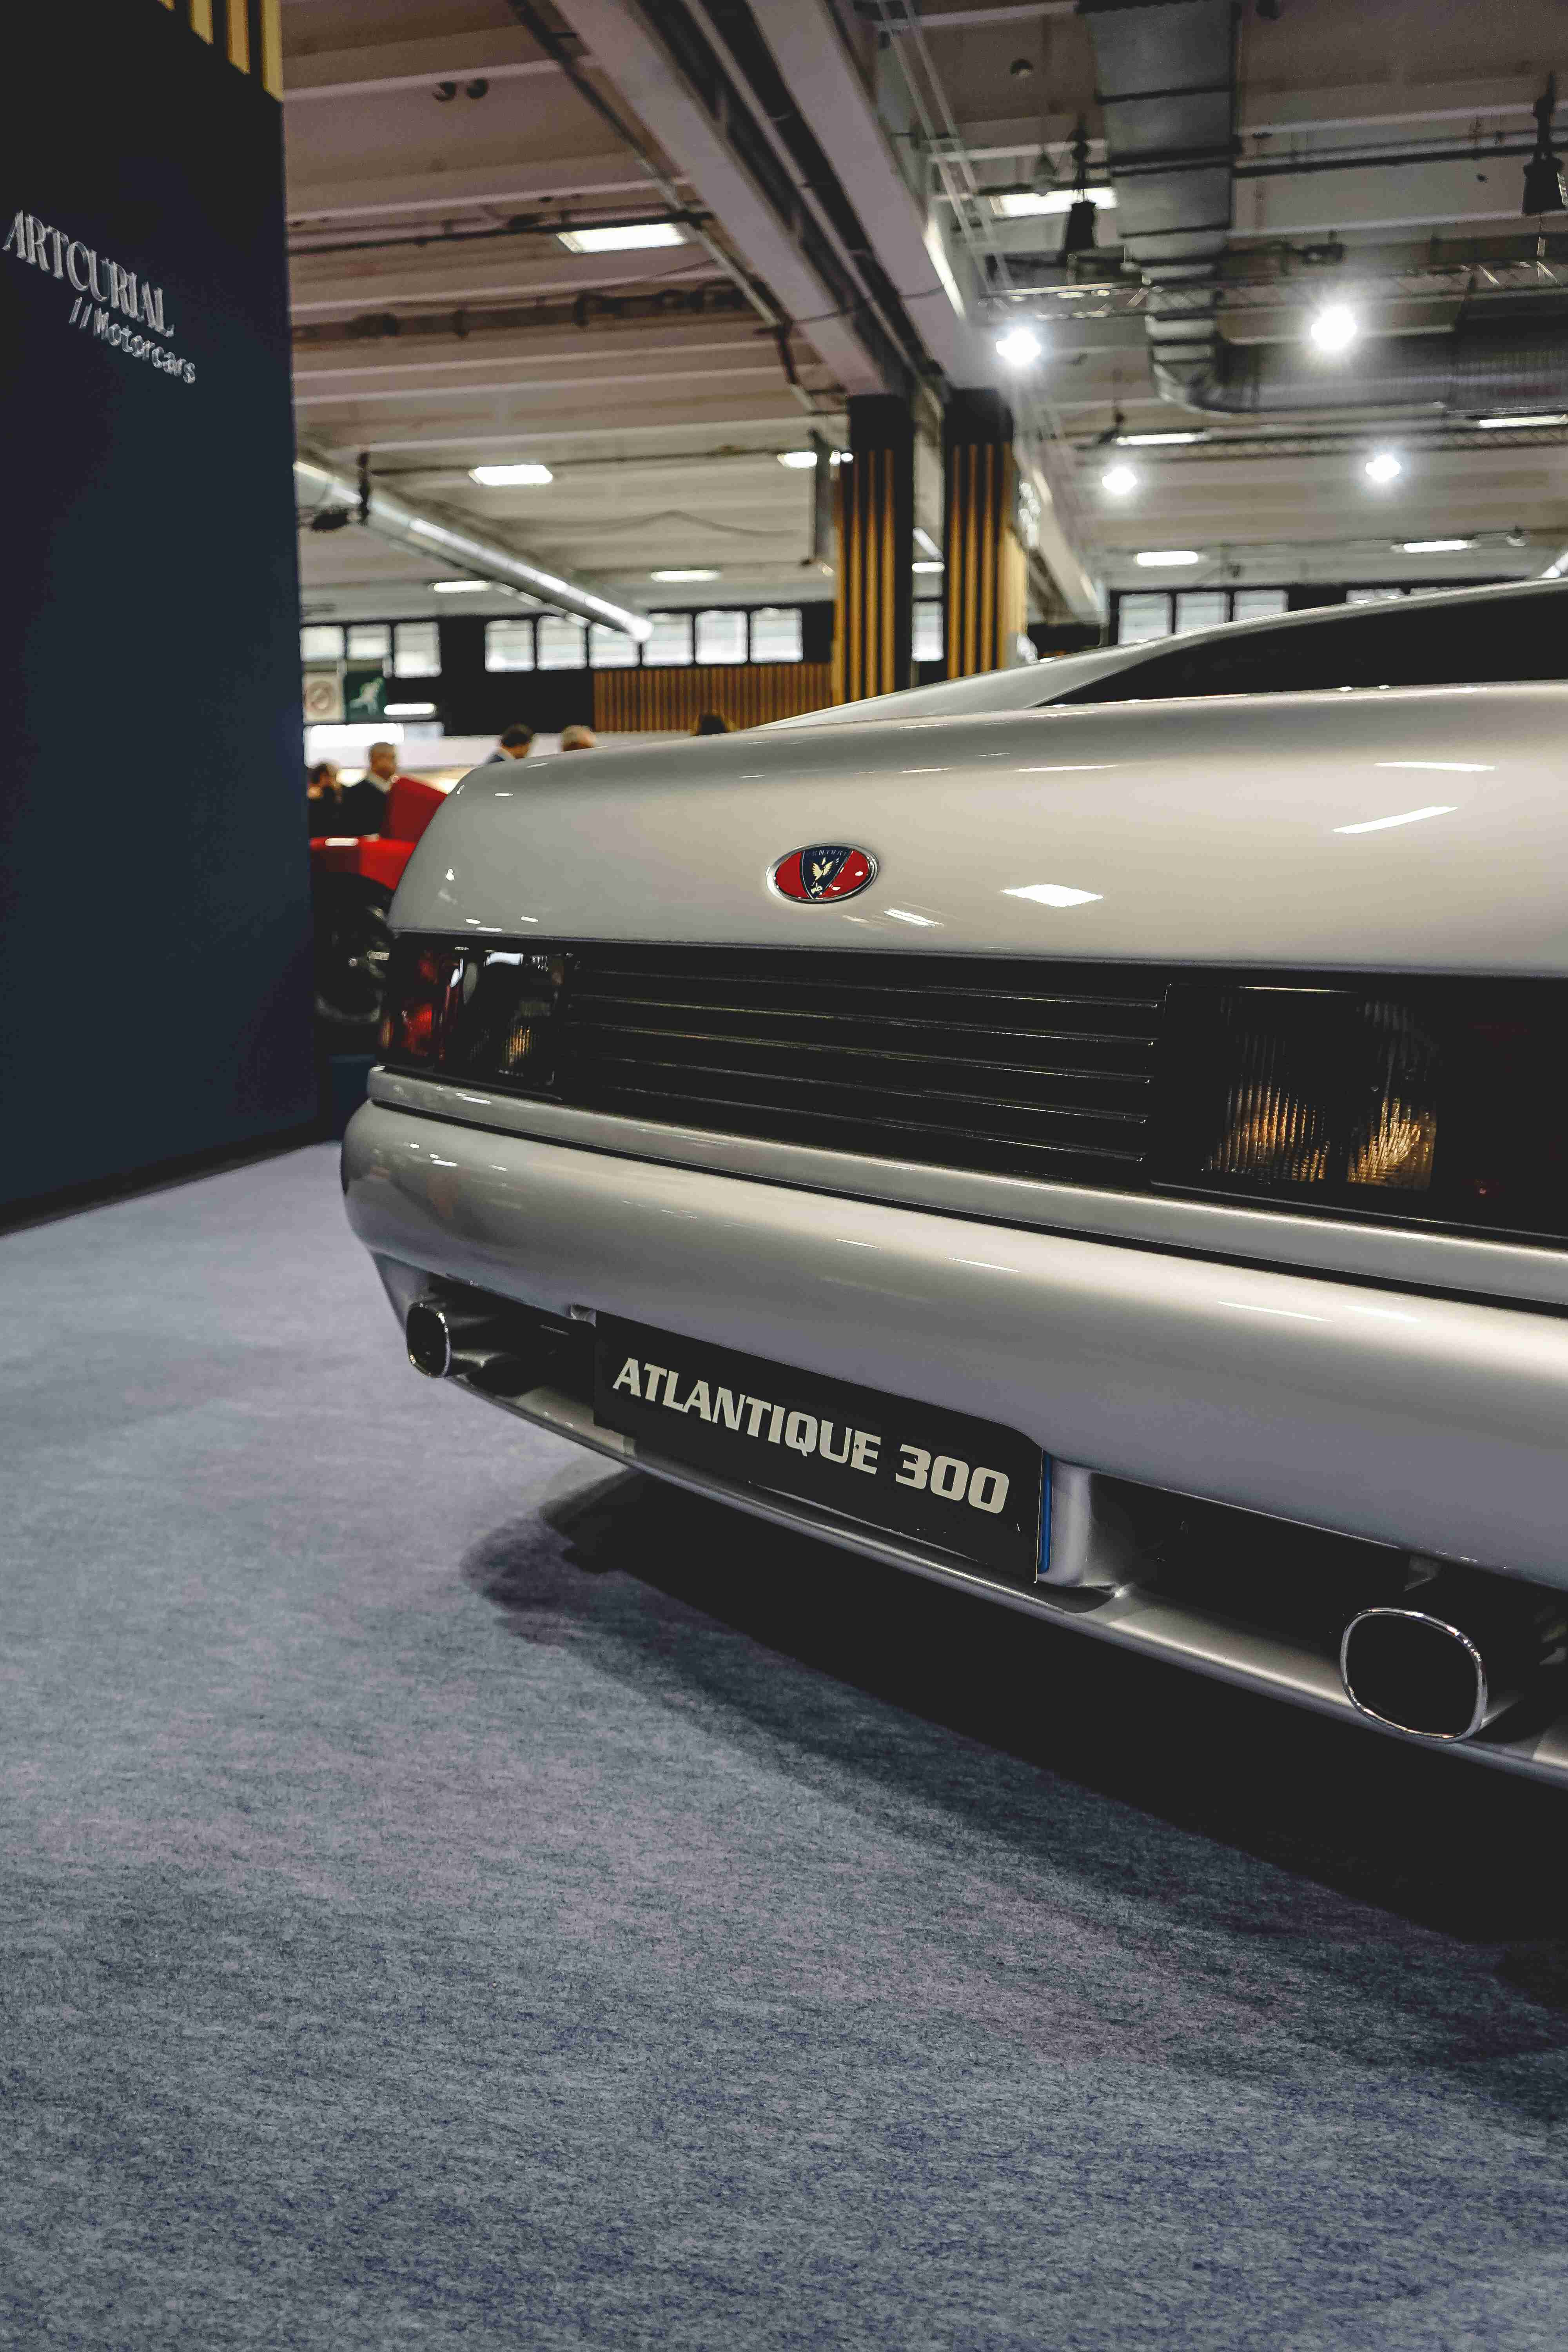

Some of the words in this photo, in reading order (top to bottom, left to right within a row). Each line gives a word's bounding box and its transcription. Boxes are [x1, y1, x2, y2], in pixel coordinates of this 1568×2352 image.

[2, 210, 174, 338] ARTCURIAL
[613, 1357, 881, 1475] ATLANTIQUE
[895, 1444, 1009, 1514] 300
